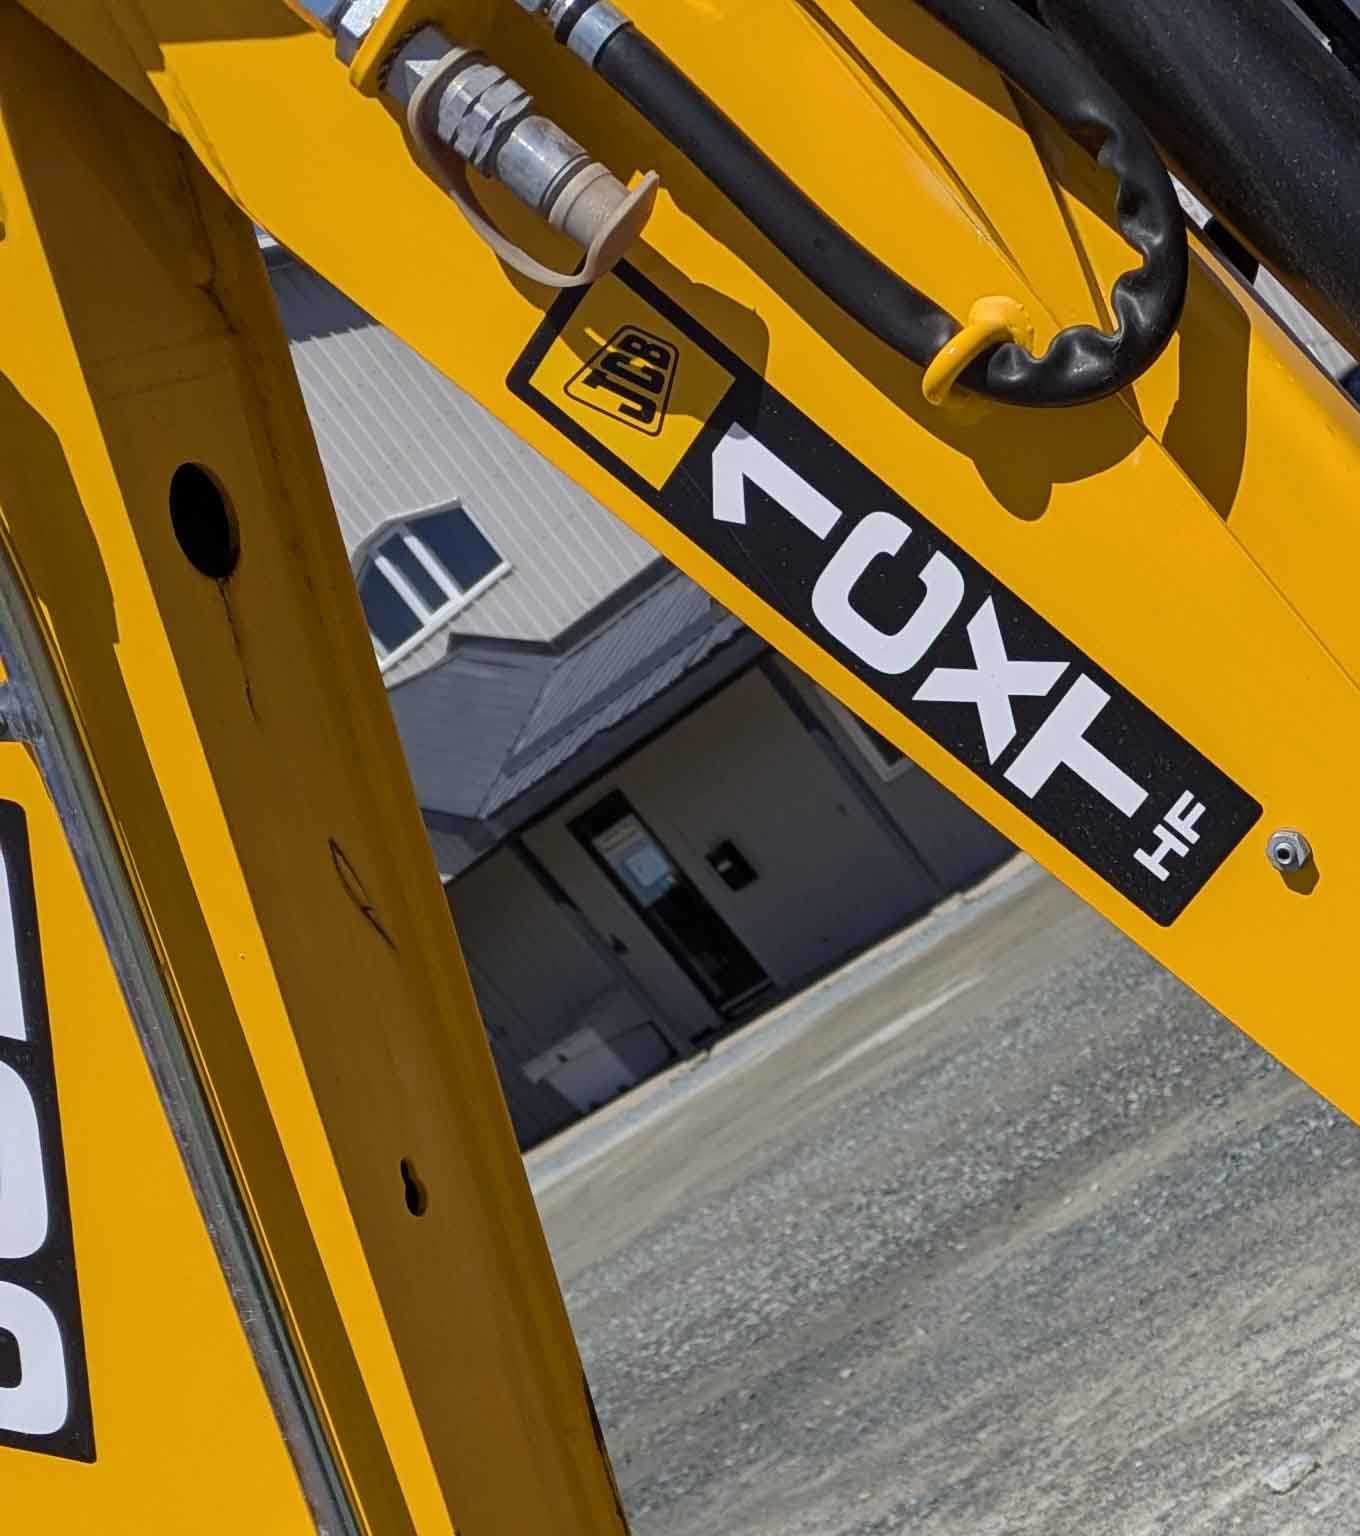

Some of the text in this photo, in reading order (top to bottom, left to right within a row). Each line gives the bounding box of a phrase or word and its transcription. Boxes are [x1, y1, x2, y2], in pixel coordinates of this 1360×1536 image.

[583, 334, 671, 424] JCB
[711, 423, 1149, 819] 1CXT
[1133, 790, 1206, 882] HF
